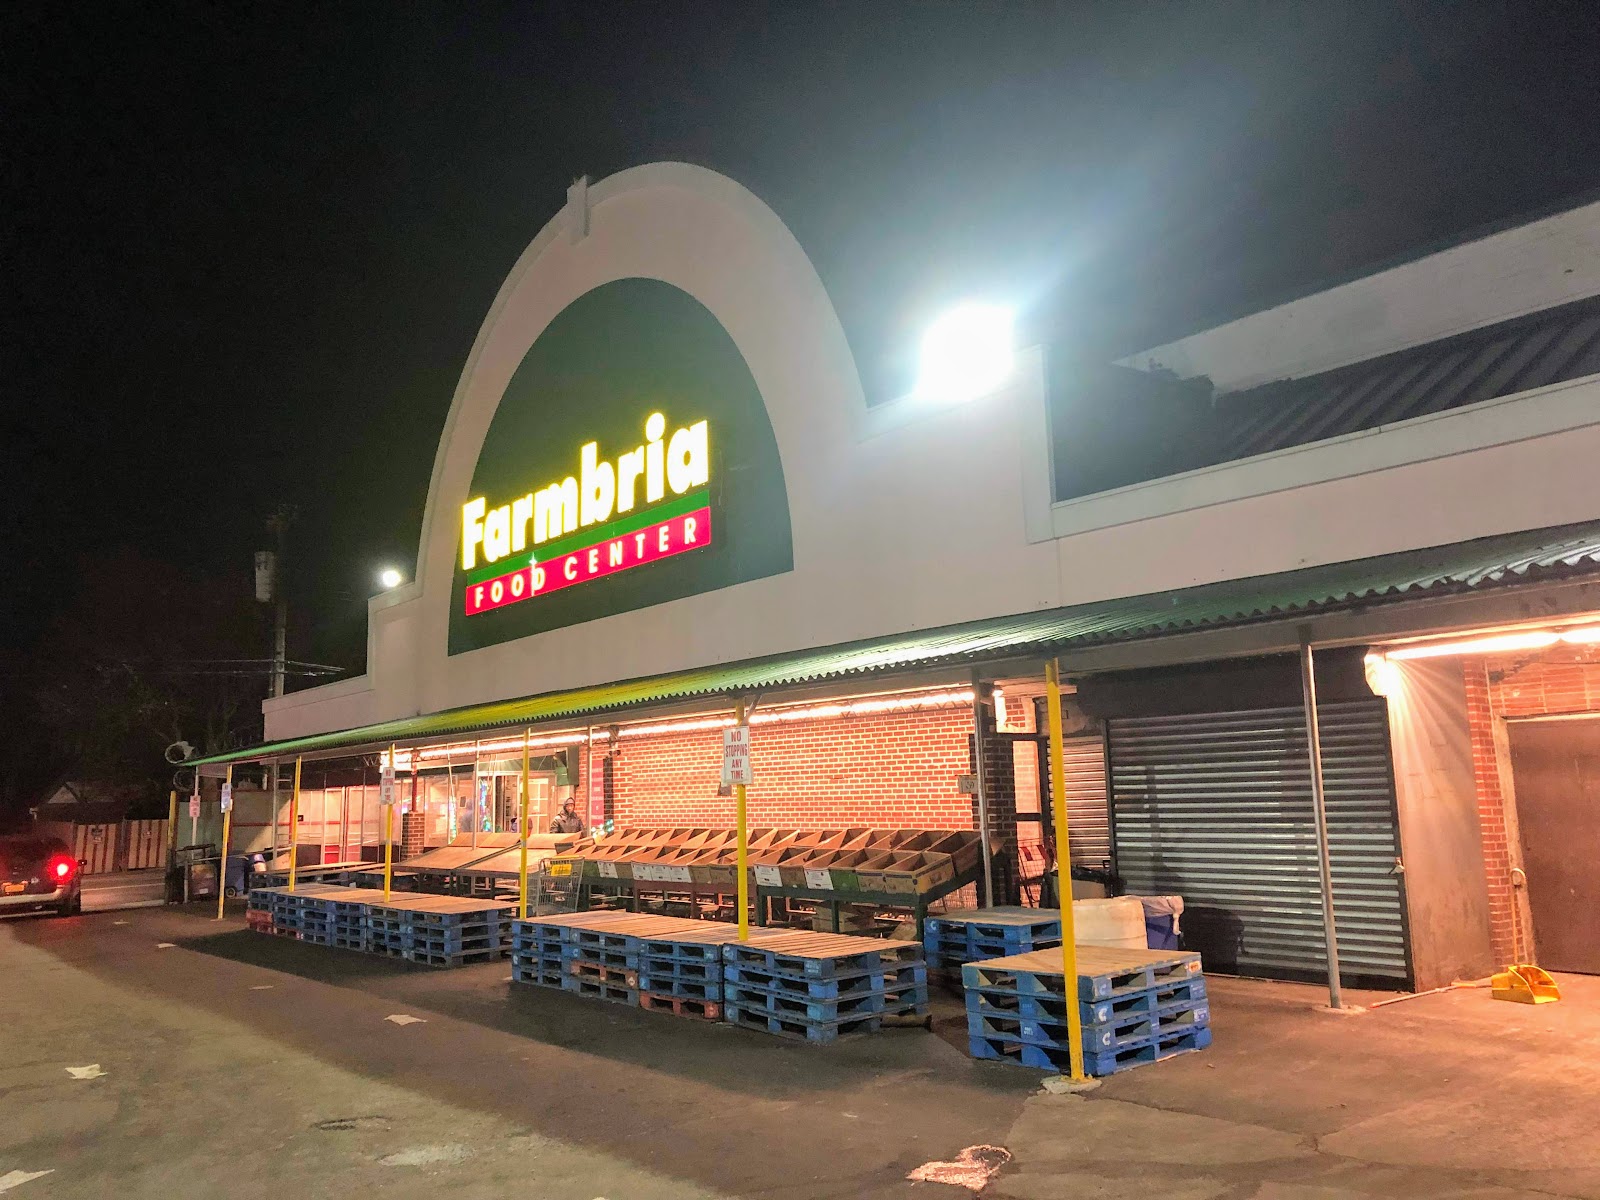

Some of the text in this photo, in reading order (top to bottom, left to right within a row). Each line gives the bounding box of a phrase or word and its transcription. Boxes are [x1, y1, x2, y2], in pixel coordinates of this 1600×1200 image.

[462, 412, 709, 571] Farmbria
[474, 517, 697, 608] FOOD CENTER
[731, 731, 742, 742] NO
[725, 744, 748, 757] STOPPING
[732, 759, 743, 768] ANY
[731, 770, 744, 779] TIME
[1099, 1007, 1108, 1022] C
[1103, 1032, 1111, 1046] C
